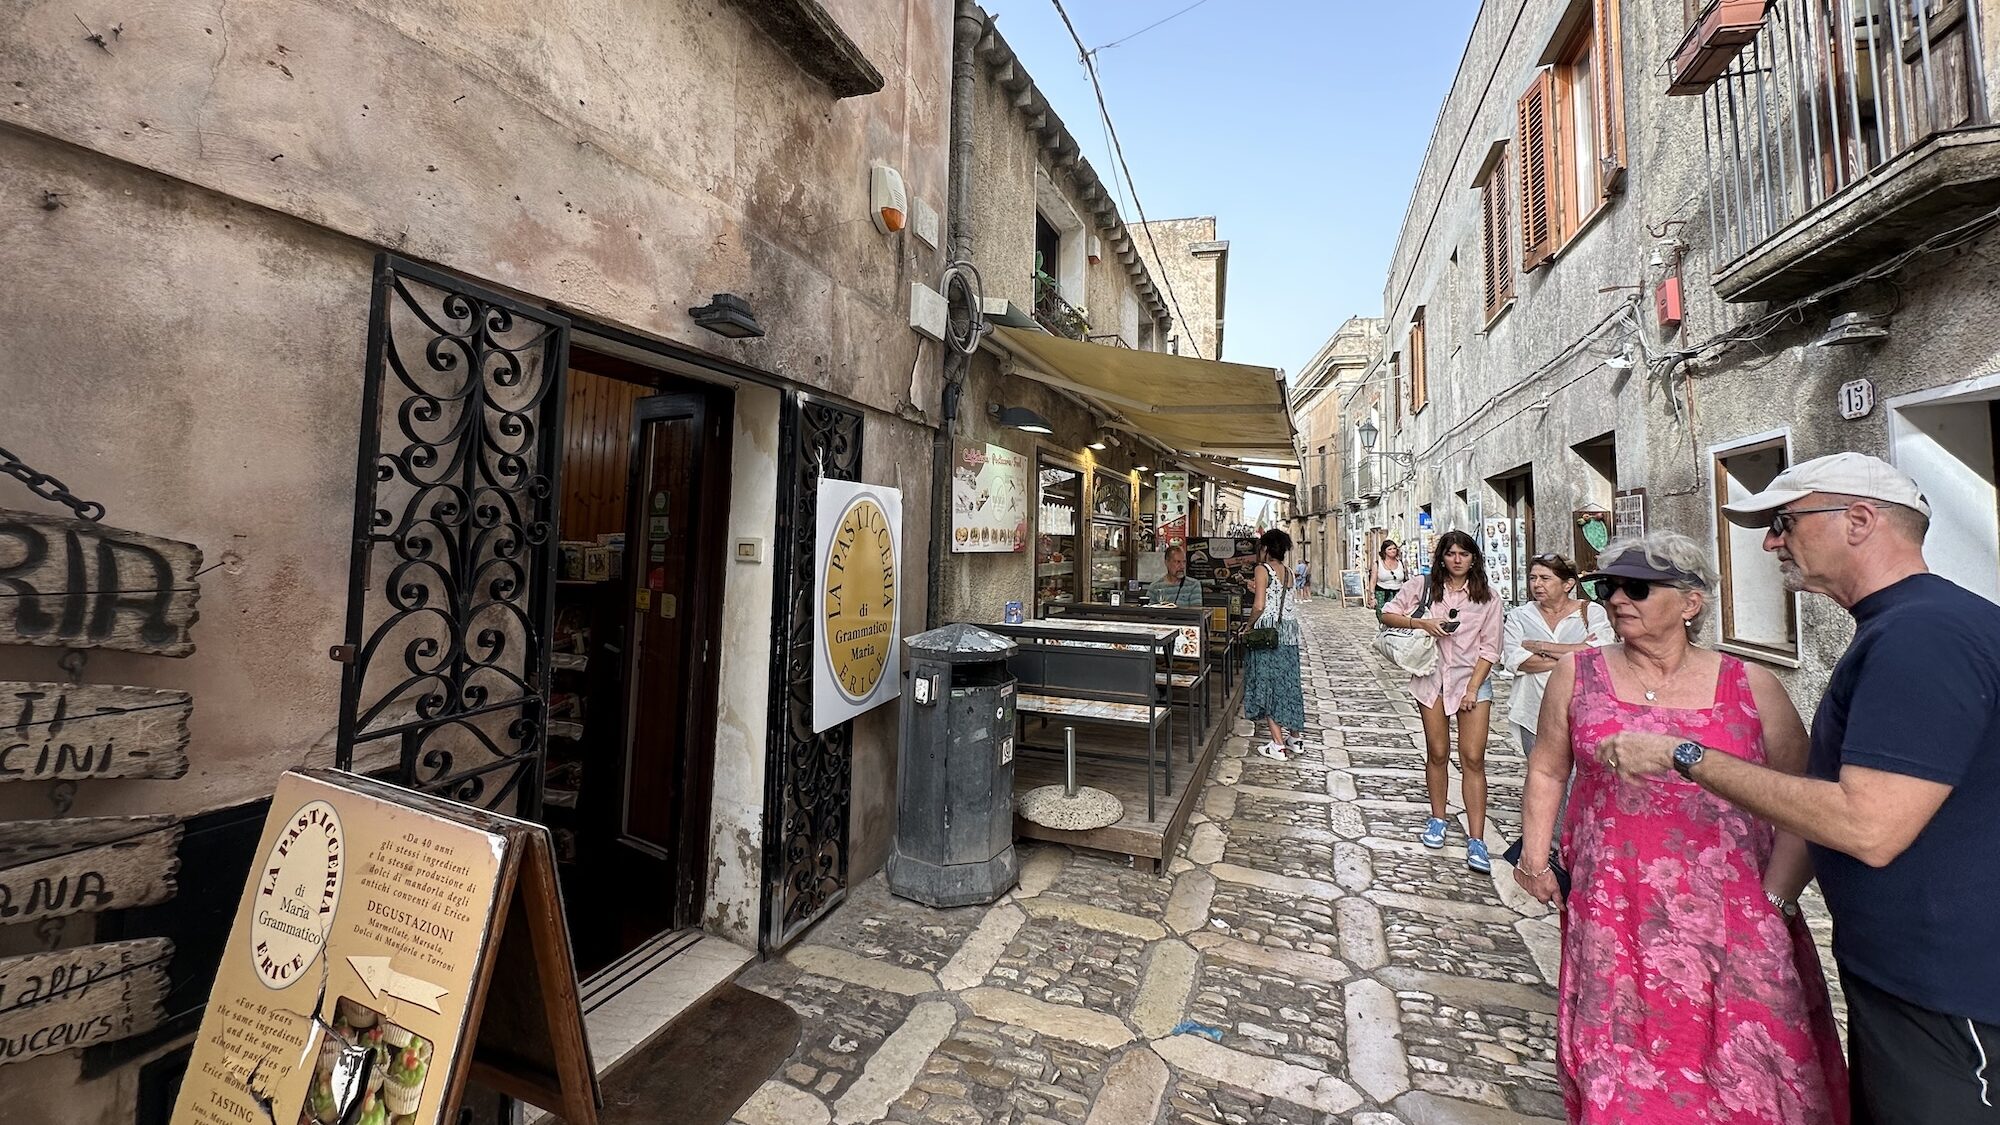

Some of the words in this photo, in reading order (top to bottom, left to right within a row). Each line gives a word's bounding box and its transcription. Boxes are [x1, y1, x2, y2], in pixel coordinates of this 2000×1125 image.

[1845, 385, 1863, 412] 15
[832, 505, 893, 608] PASTICCERIA
[828, 583, 841, 619] LA
[859, 603, 868, 617] di
[835, 620, 888, 644] Grammatico
[851, 643, 875, 662] Maria
[838, 652, 883, 694] ERICE
[262, 866, 281, 897] LA
[278, 807, 340, 915] PASTICCERIA
[380, 840, 393, 851] gli
[395, 843, 420, 859] stessi
[423, 853, 471, 876] ingredienti
[421, 838, 432, 848] 40
[434, 843, 454, 856] anni
[294, 883, 306, 898] di
[369, 851, 374, 859] e
[377, 851, 385, 862] la
[387, 858, 413, 872] stessa
[415, 867, 464, 890] produzione
[466, 882, 476, 894] di
[369, 864, 390, 879] dolci
[392, 872, 402, 883] di
[404, 878, 445, 898] mandorla
[447, 891, 470, 908] degli
[279, 896, 310, 920] Maria
[360, 877, 391, 894] antichi
[393, 888, 429, 908] conventi
[431, 900, 441, 912] di
[258, 910, 321, 946] Grammatico
[367, 900, 454, 943] DEGUSTAZIONI
[368, 917, 410, 941] Marmellate,
[413, 934, 444, 955] Marsala,
[256, 939, 304, 980] ERICE
[353, 924, 373, 939] Dolci
[374, 932, 383, 943] di
[384, 935, 418, 957] Mandorla
[427, 954, 455, 973] Torroni
[217, 1004, 230, 1017] the
[232, 1012, 253, 1027] same
[255, 1020, 304, 1047] ingredients
[256, 1004, 268, 1016] 40
[268, 1010, 293, 1026] years
[211, 1034, 242, 1054] almond
[280, 1065, 293, 1078] of
[226, 1025, 244, 1038] and
[244, 1031, 260, 1046] the
[261, 1040, 284, 1055] same
[202, 1062, 222, 1080] Erice
[209, 1090, 255, 1124] TASTING
